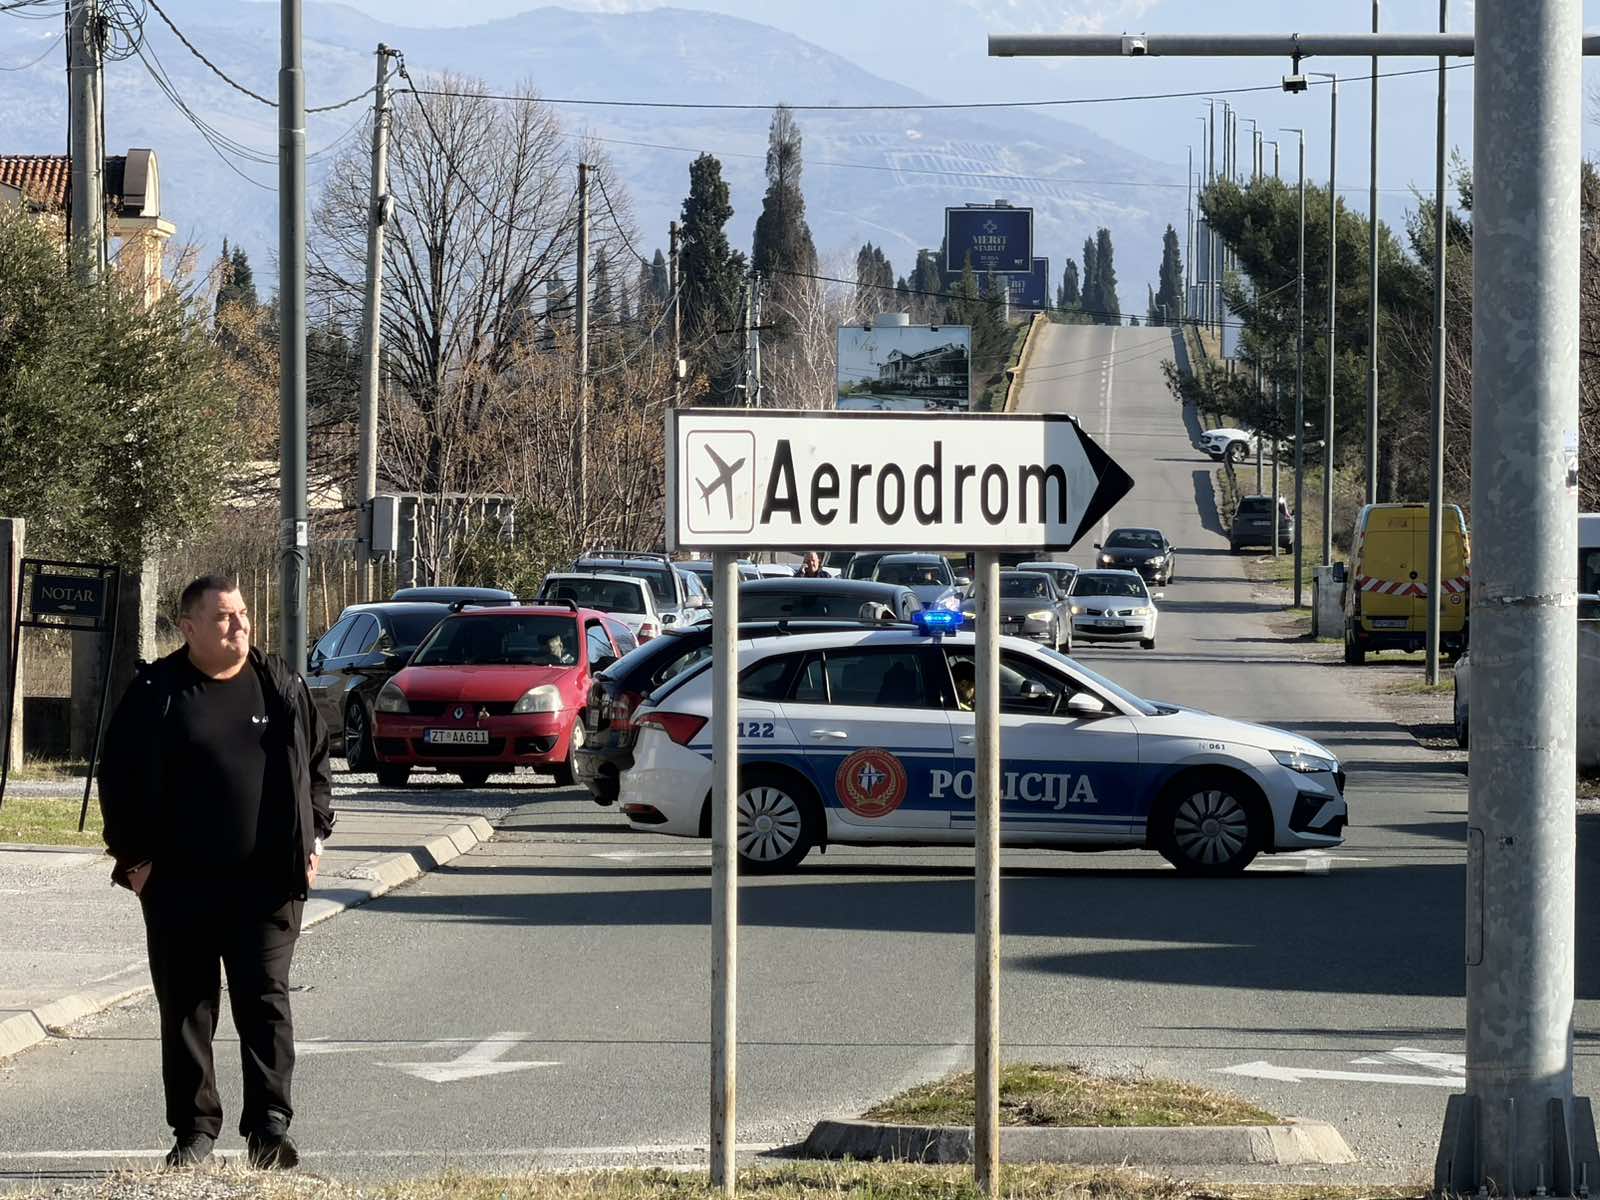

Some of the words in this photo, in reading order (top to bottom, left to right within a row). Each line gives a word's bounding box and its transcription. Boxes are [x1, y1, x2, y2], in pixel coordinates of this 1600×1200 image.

[760, 439, 1067, 526] Aerodrom
[41, 586, 95, 602] NOTAR
[432, 731, 446, 742] ZT
[452, 731, 487, 743] AA611
[737, 722, 774, 737] 122
[929, 769, 1098, 810] POICIJA
